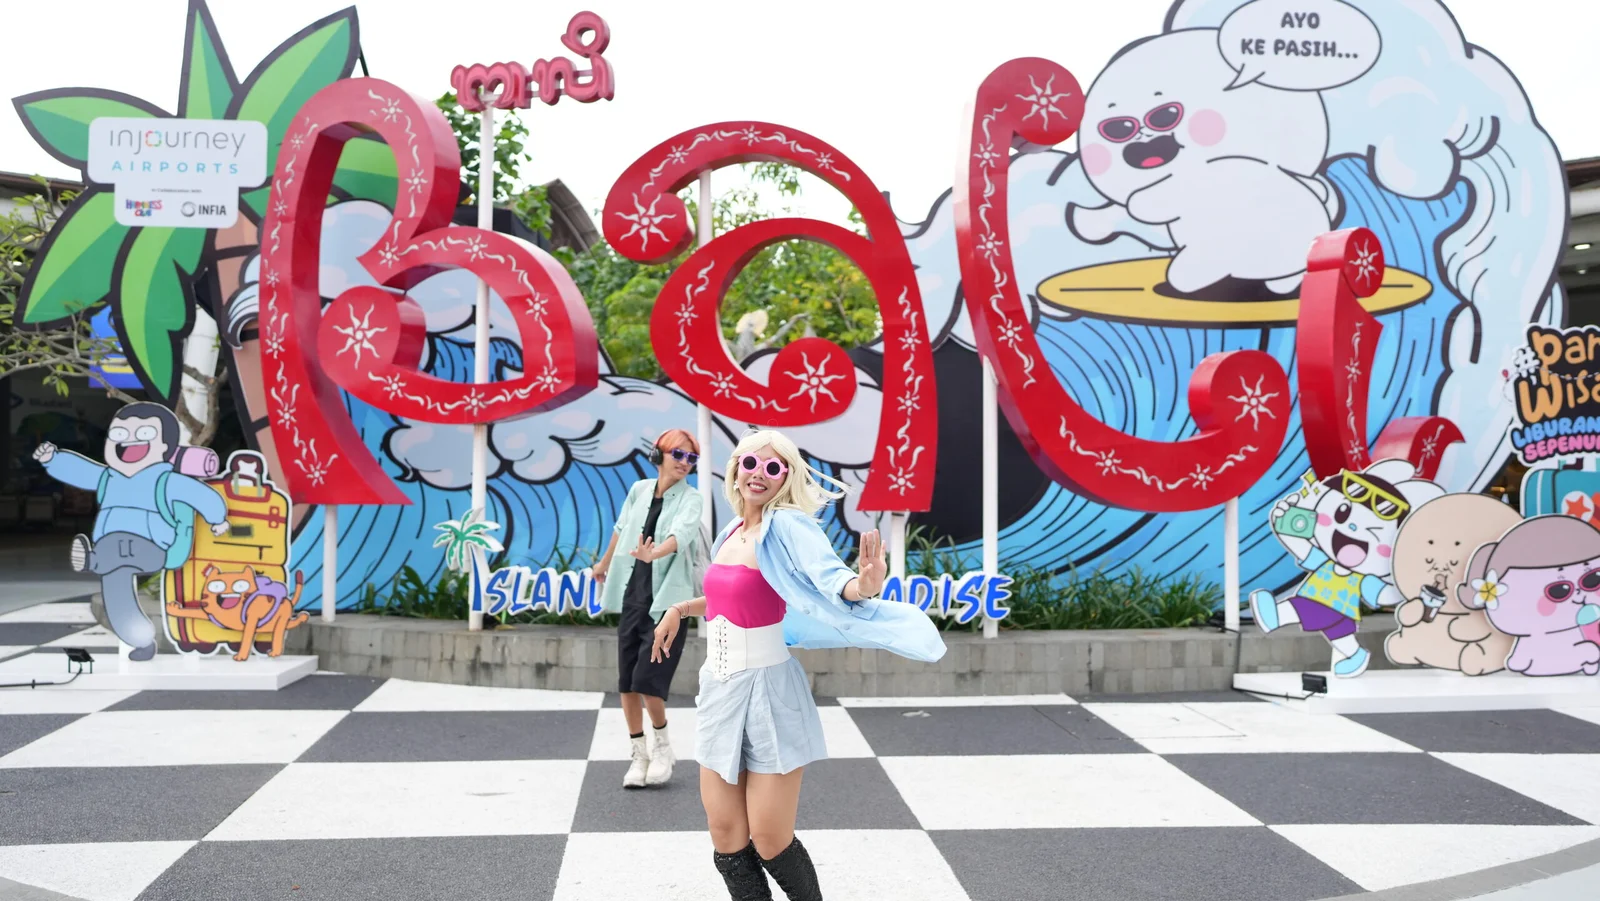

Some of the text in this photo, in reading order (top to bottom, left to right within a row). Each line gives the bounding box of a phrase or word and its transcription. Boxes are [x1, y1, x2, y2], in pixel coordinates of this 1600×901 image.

[1280, 12, 1320, 29] AYO
[1240, 38, 1358, 59] KE PASIH...
[111, 160, 239, 175] AIRPORTS
[198, 204, 227, 215] INFIA
[1524, 434, 1600, 462] SEPENU
